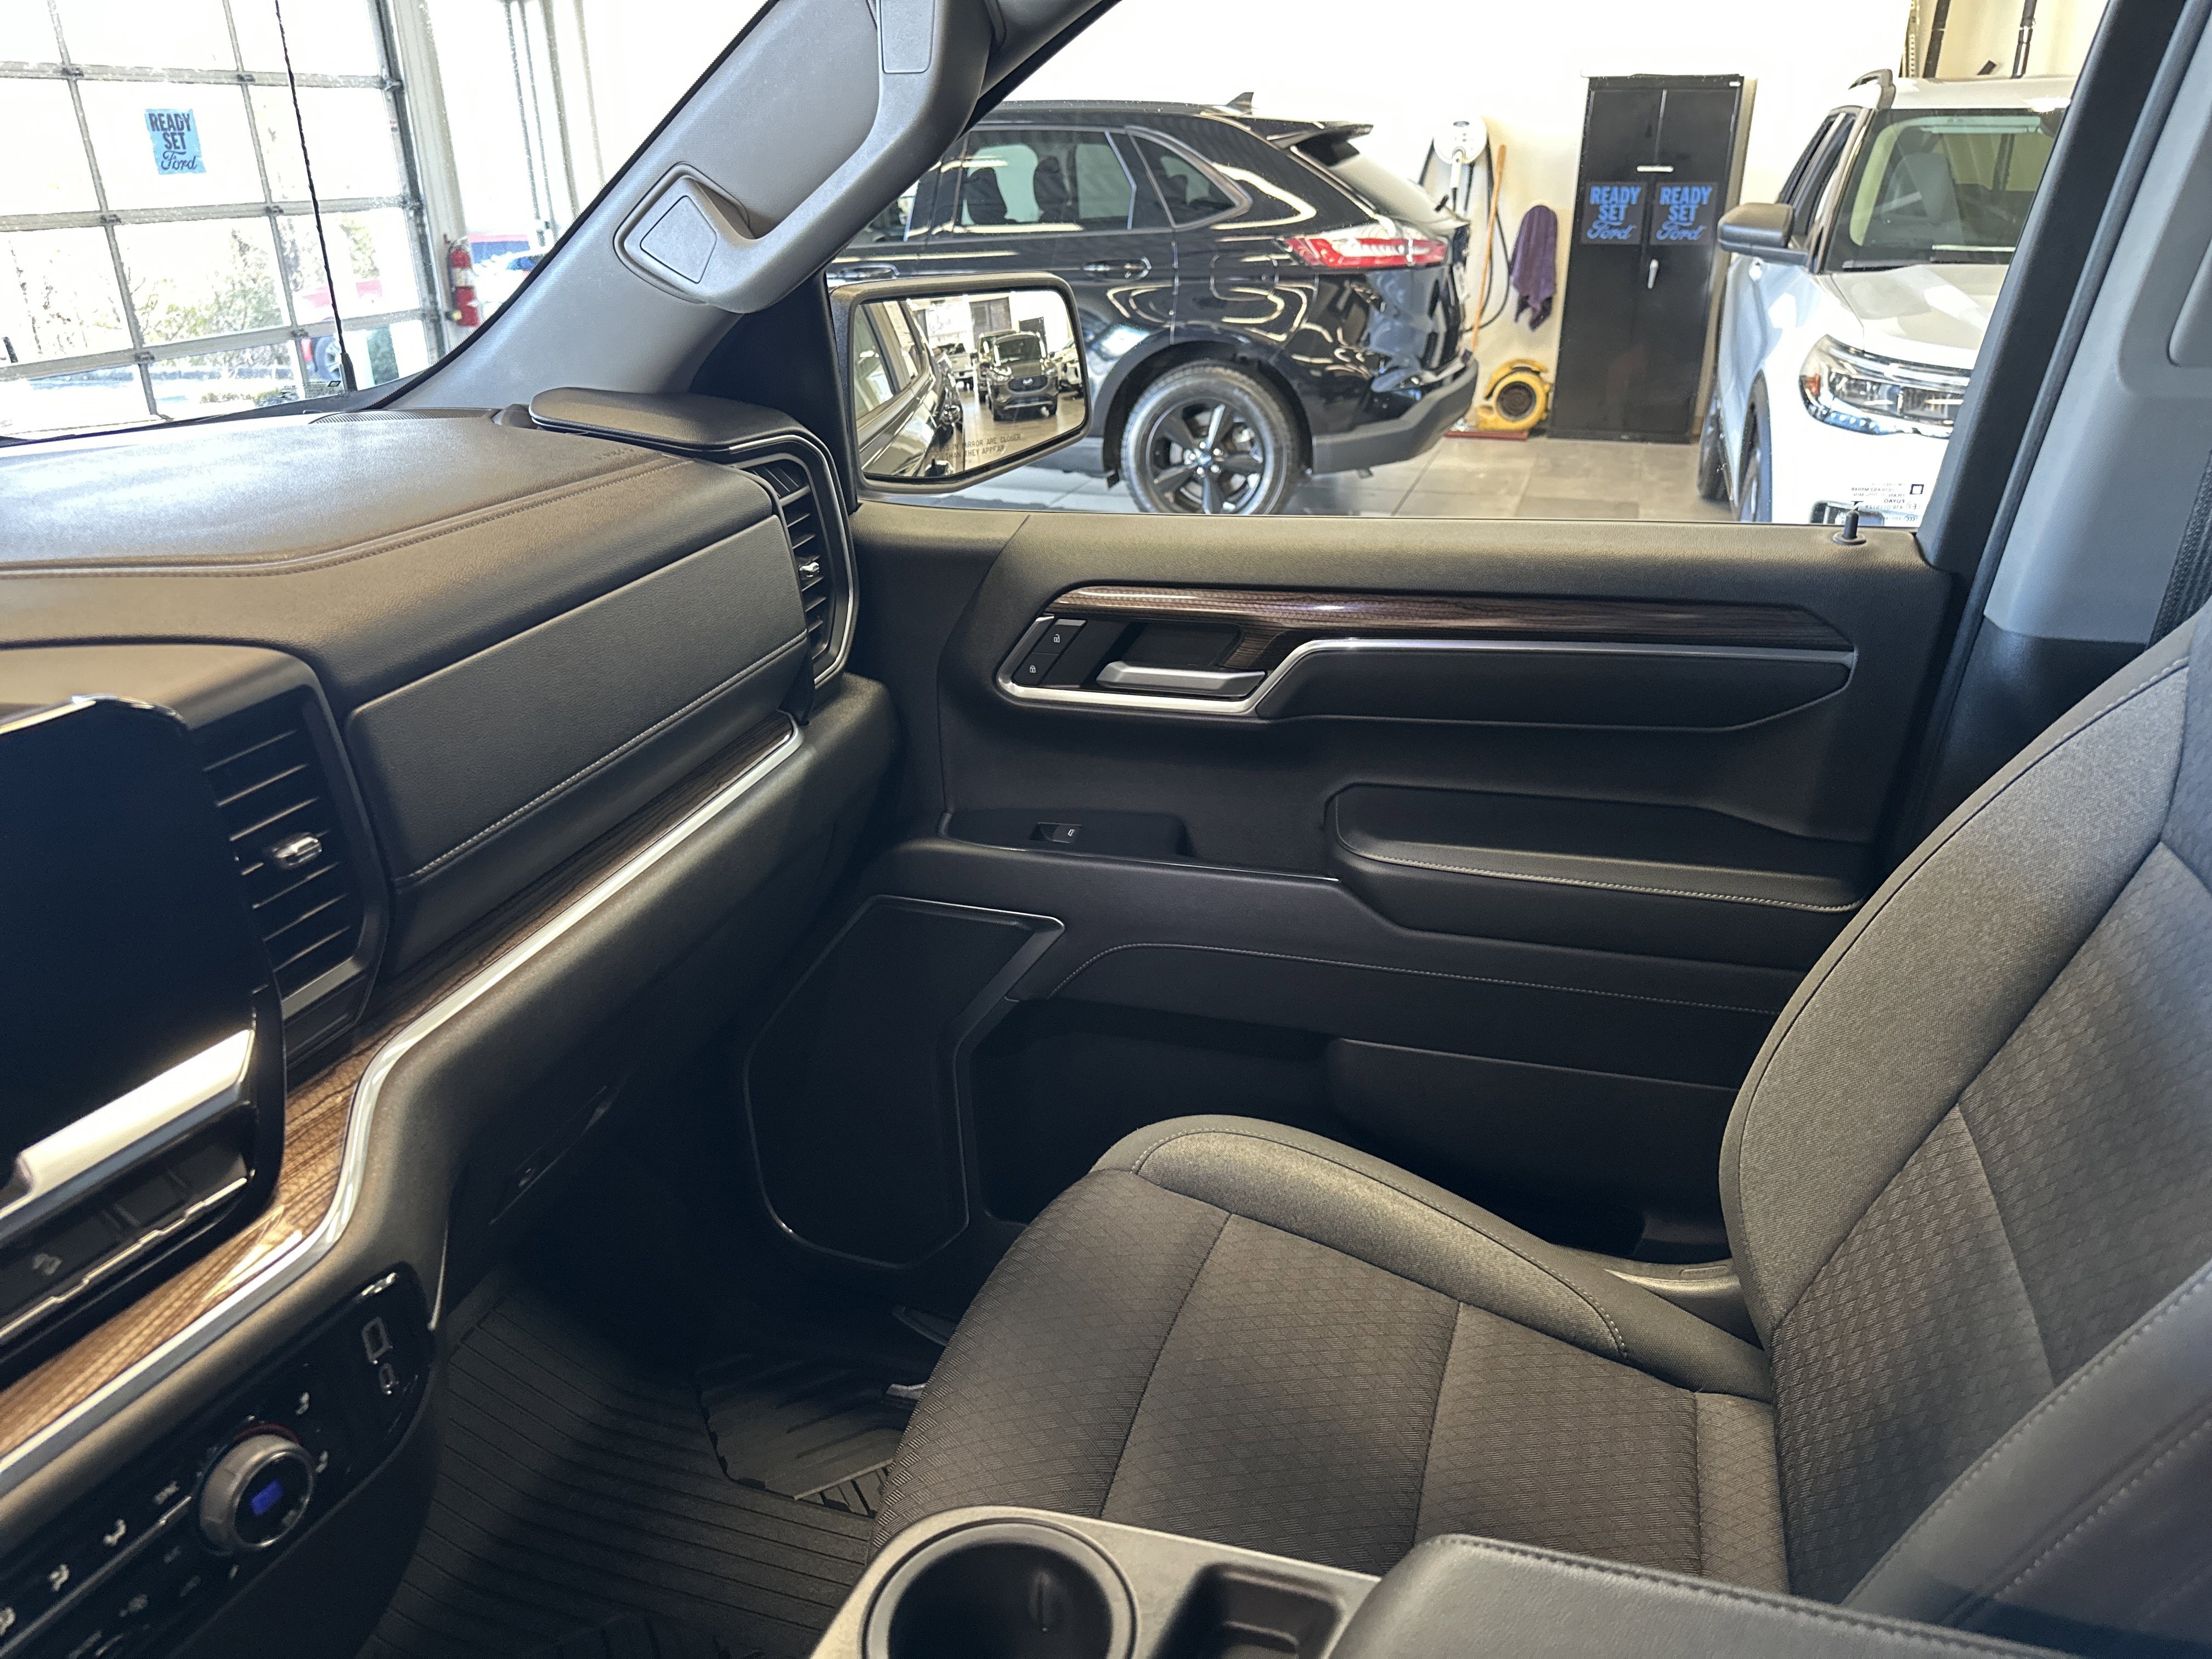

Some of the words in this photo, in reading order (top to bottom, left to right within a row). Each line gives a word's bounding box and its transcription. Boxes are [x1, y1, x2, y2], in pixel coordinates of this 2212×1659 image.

[149, 113, 191, 132] READY
[162, 132, 186, 149] SET
[161, 150, 198, 170] Ford
[1590, 185, 1641, 205] READY
[1659, 185, 1712, 205] READY
[1598, 204, 1628, 221] SET
[1668, 204, 1699, 221] SET
[1587, 220, 1637, 240] Ford
[1656, 220, 1708, 240] Ford
[1000, 433, 1021, 443] CLOSER
[982, 445, 1005, 455] APPEAR
